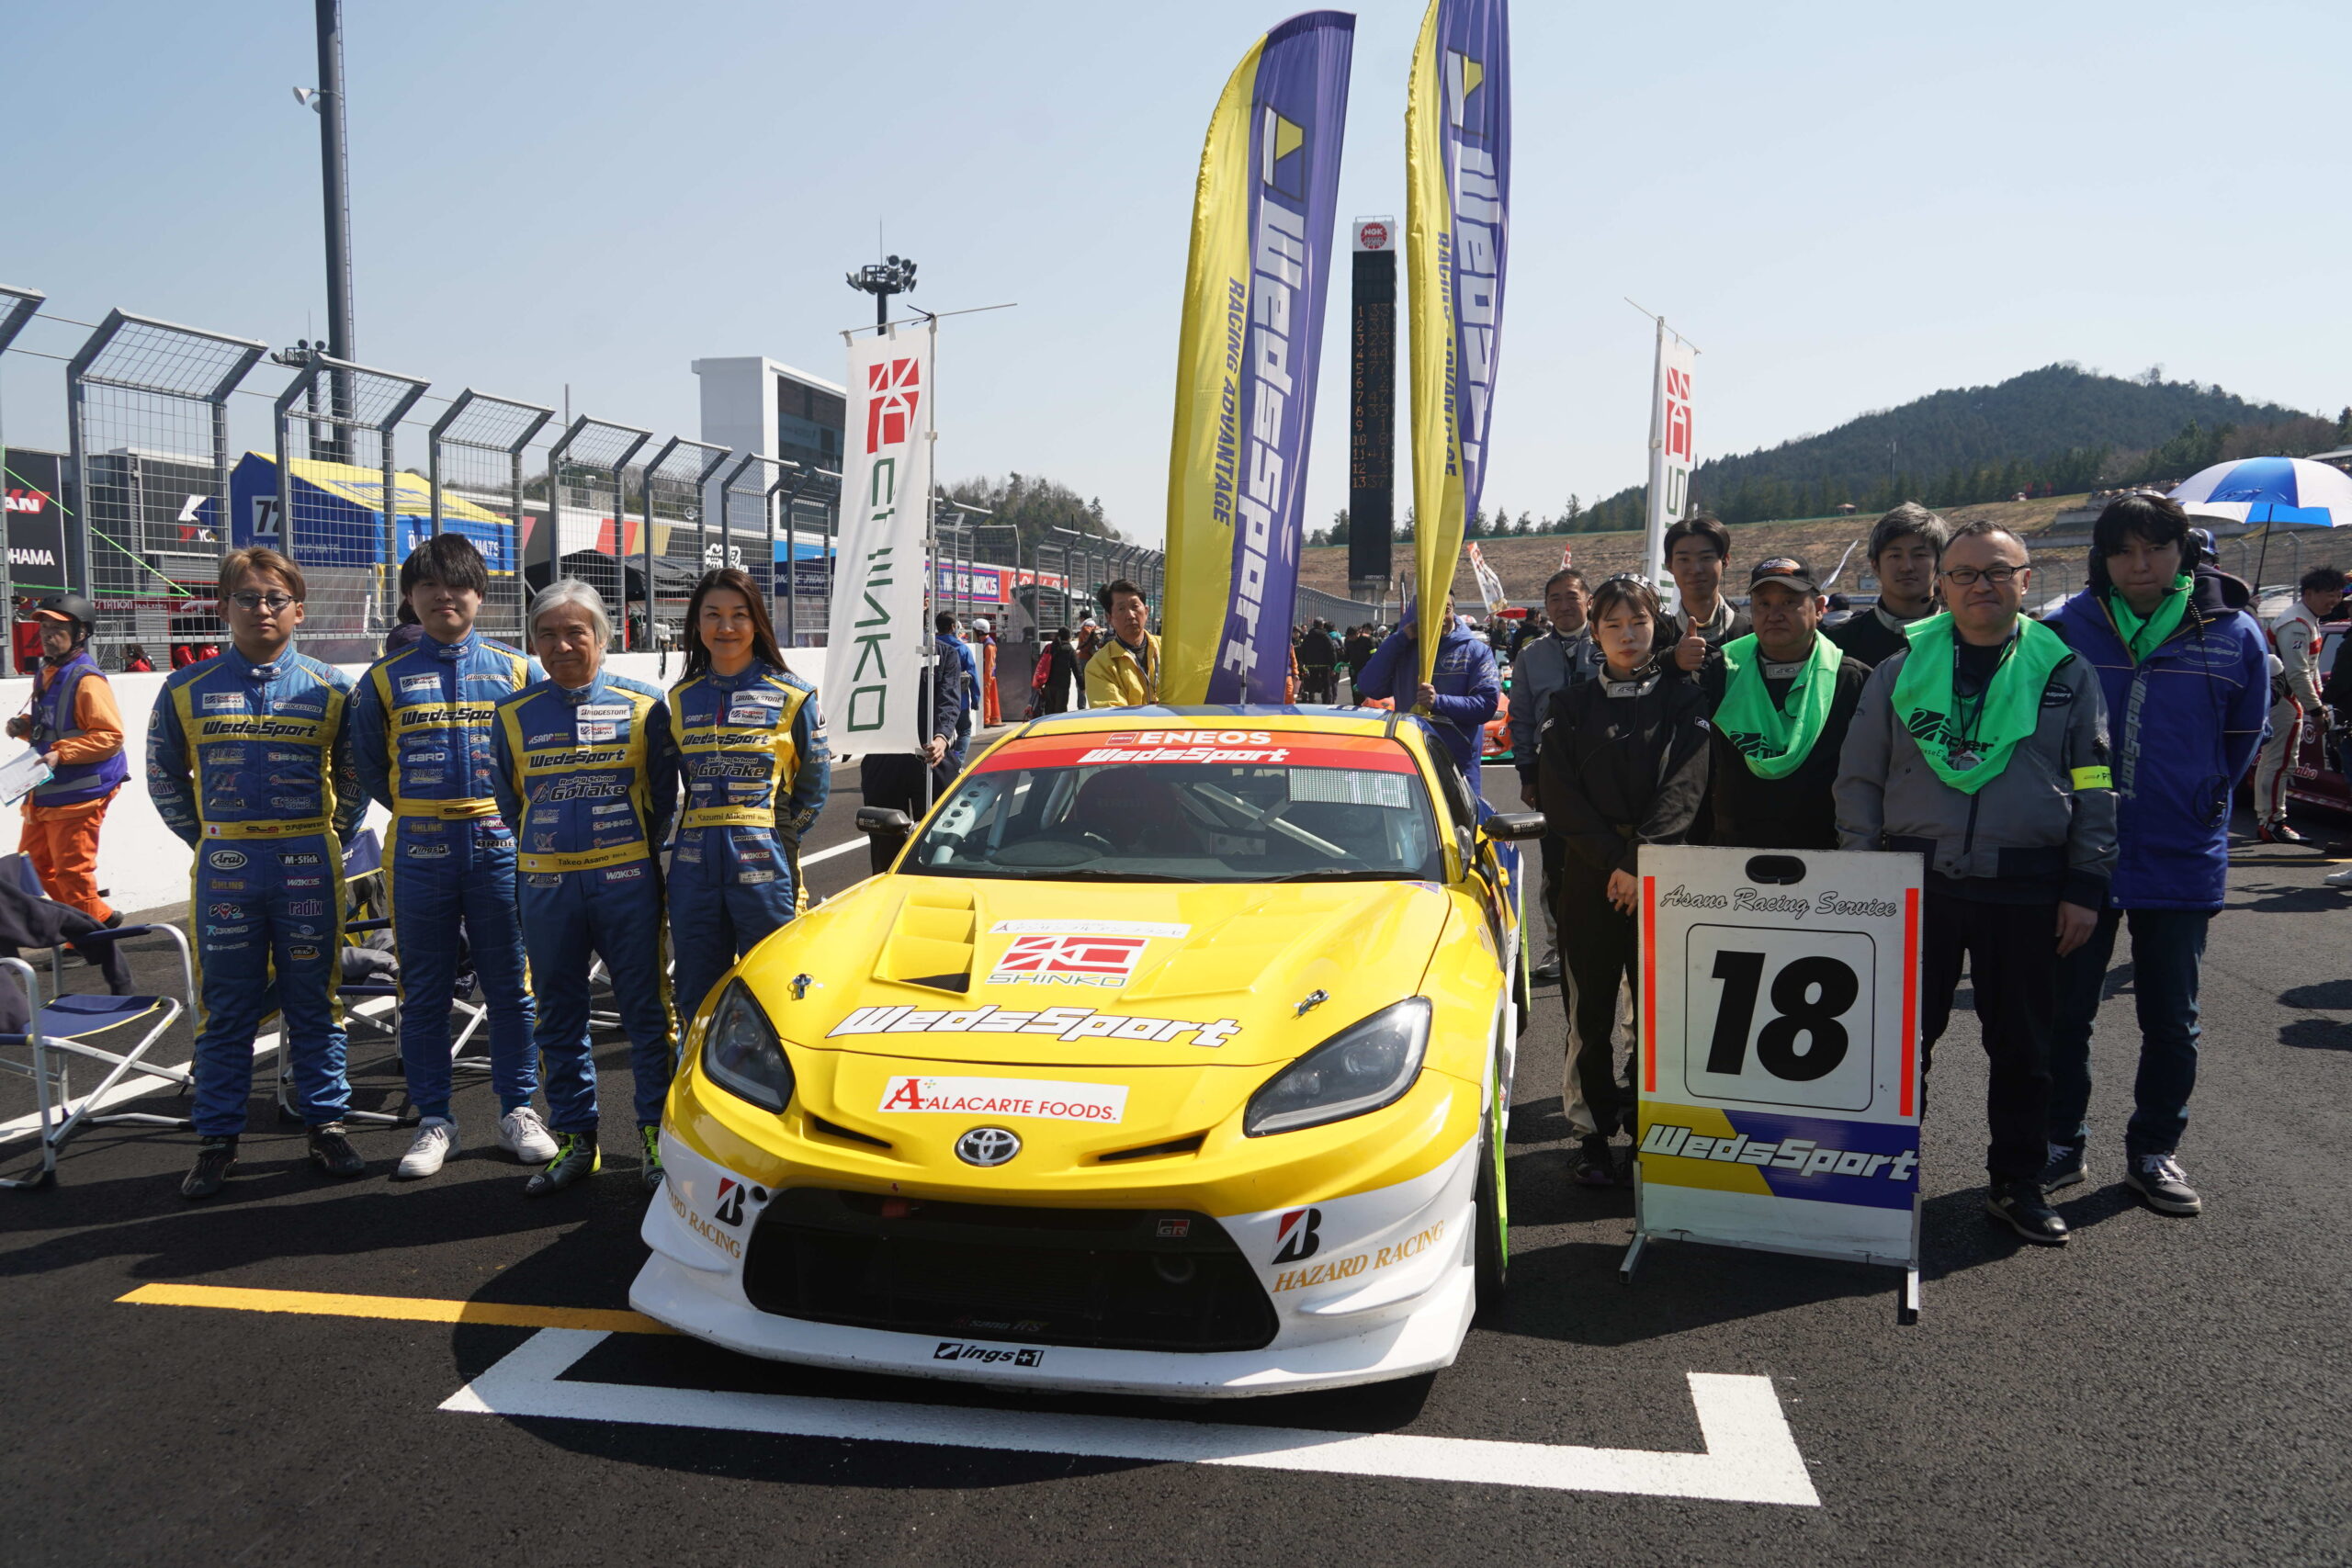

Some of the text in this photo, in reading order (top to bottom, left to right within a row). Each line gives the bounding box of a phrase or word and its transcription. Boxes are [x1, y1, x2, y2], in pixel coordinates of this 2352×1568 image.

[1364, 228, 1383, 236] NGK
[1213, 276, 1246, 526] RACING ADVANTAGE
[1223, 195, 1304, 675] WedsSport
[401, 707, 495, 727] WedsSpo
[202, 720, 318, 738] WedsSport
[1138, 731, 1272, 744] ENEOS
[529, 749, 626, 768] WedsSport
[1077, 747, 1291, 764] WedsSport
[697, 763, 766, 777] GoTake
[559, 775, 617, 786] Racing School
[550, 782, 628, 802] GoTake
[476, 840, 514, 848] BRIDE
[210, 853, 243, 864] Arai
[284, 854, 319, 863] M-Stick
[558, 858, 582, 866] Takeo
[583, 855, 609, 865] Asano
[289, 898, 322, 916] radix
[1659, 884, 1897, 919] Asano Racing Service
[987, 973, 1128, 987] SHINKO
[1705, 949, 1860, 1082] 18
[825, 1005, 1242, 1047] WedsSport
[1638, 1122, 1918, 1181] WedsSport
[688, 1210, 741, 1259] RACING
[1159, 1225, 1187, 1237] GR
[1272, 1220, 1445, 1293] HAZARD RACING
